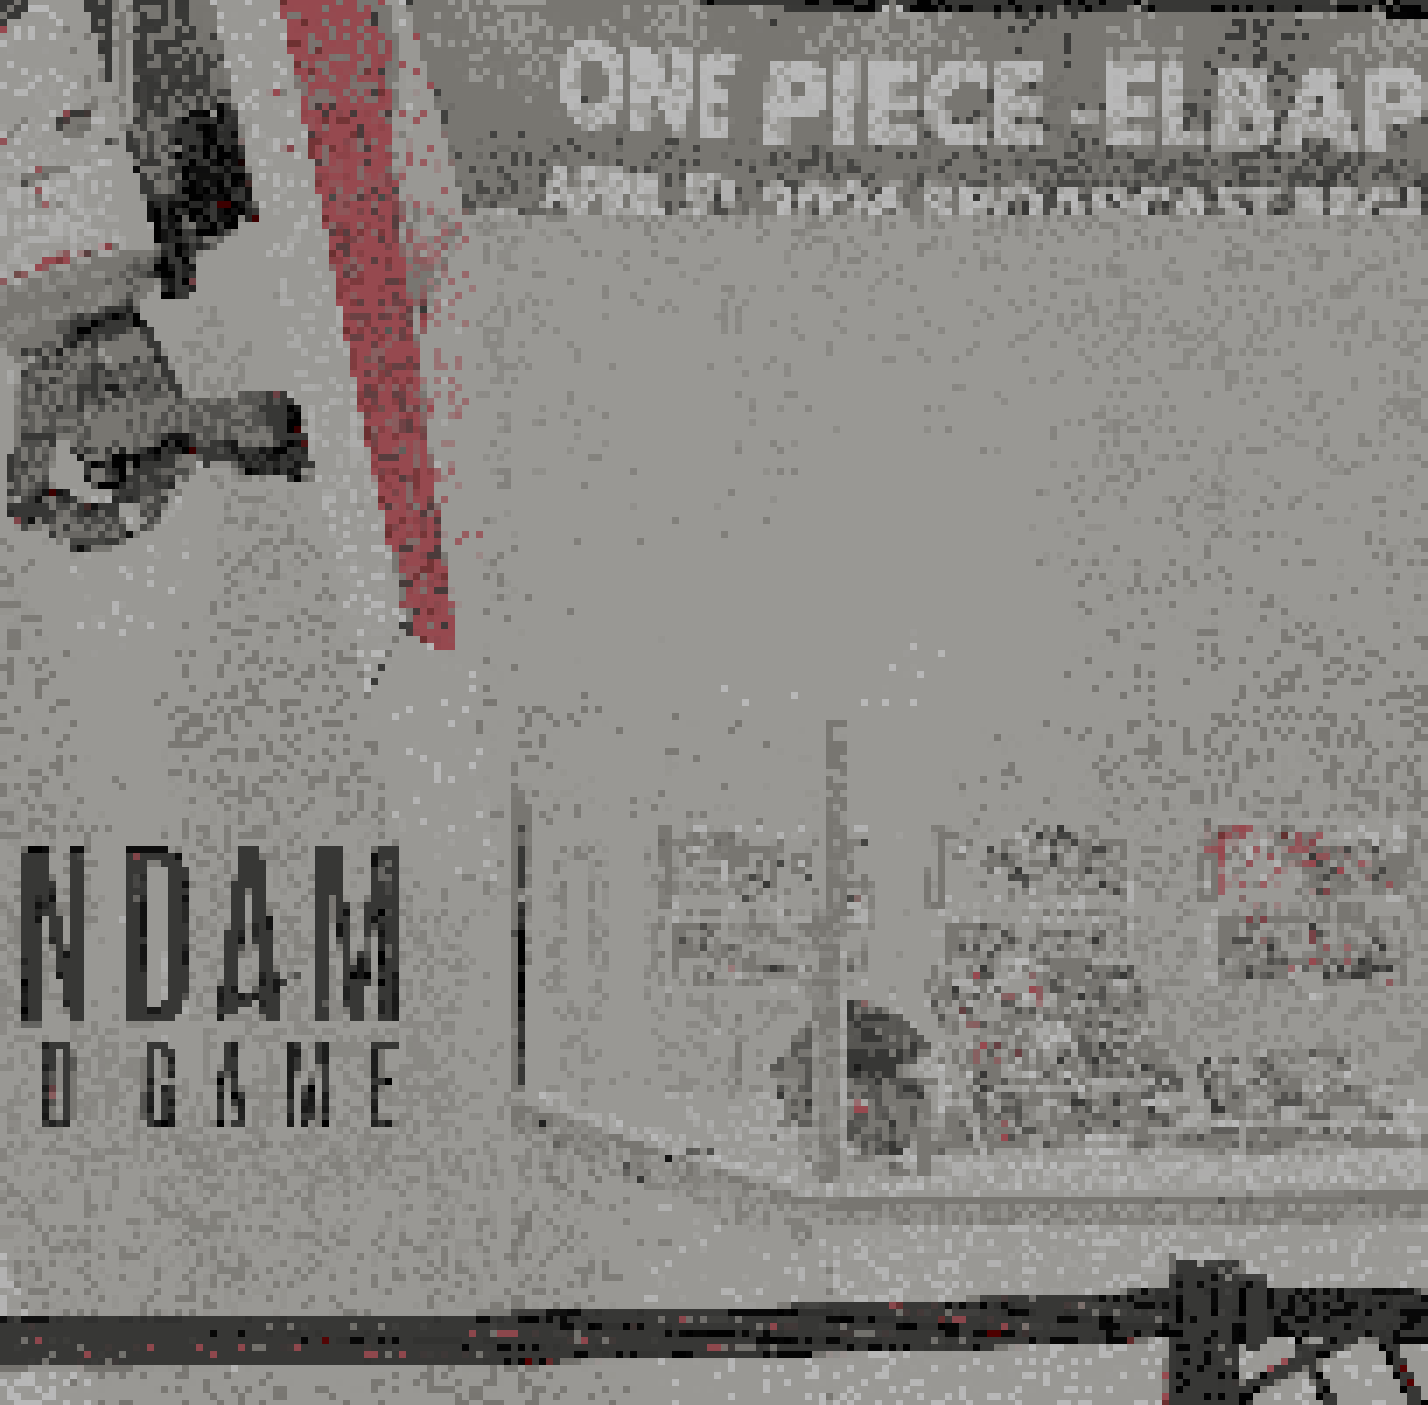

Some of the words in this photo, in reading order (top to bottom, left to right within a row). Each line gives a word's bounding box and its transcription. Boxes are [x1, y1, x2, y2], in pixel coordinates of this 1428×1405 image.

[559, 38, 740, 138] ONE
[762, 60, 1044, 146] PIECE
[147, 1042, 399, 1127] GAME
